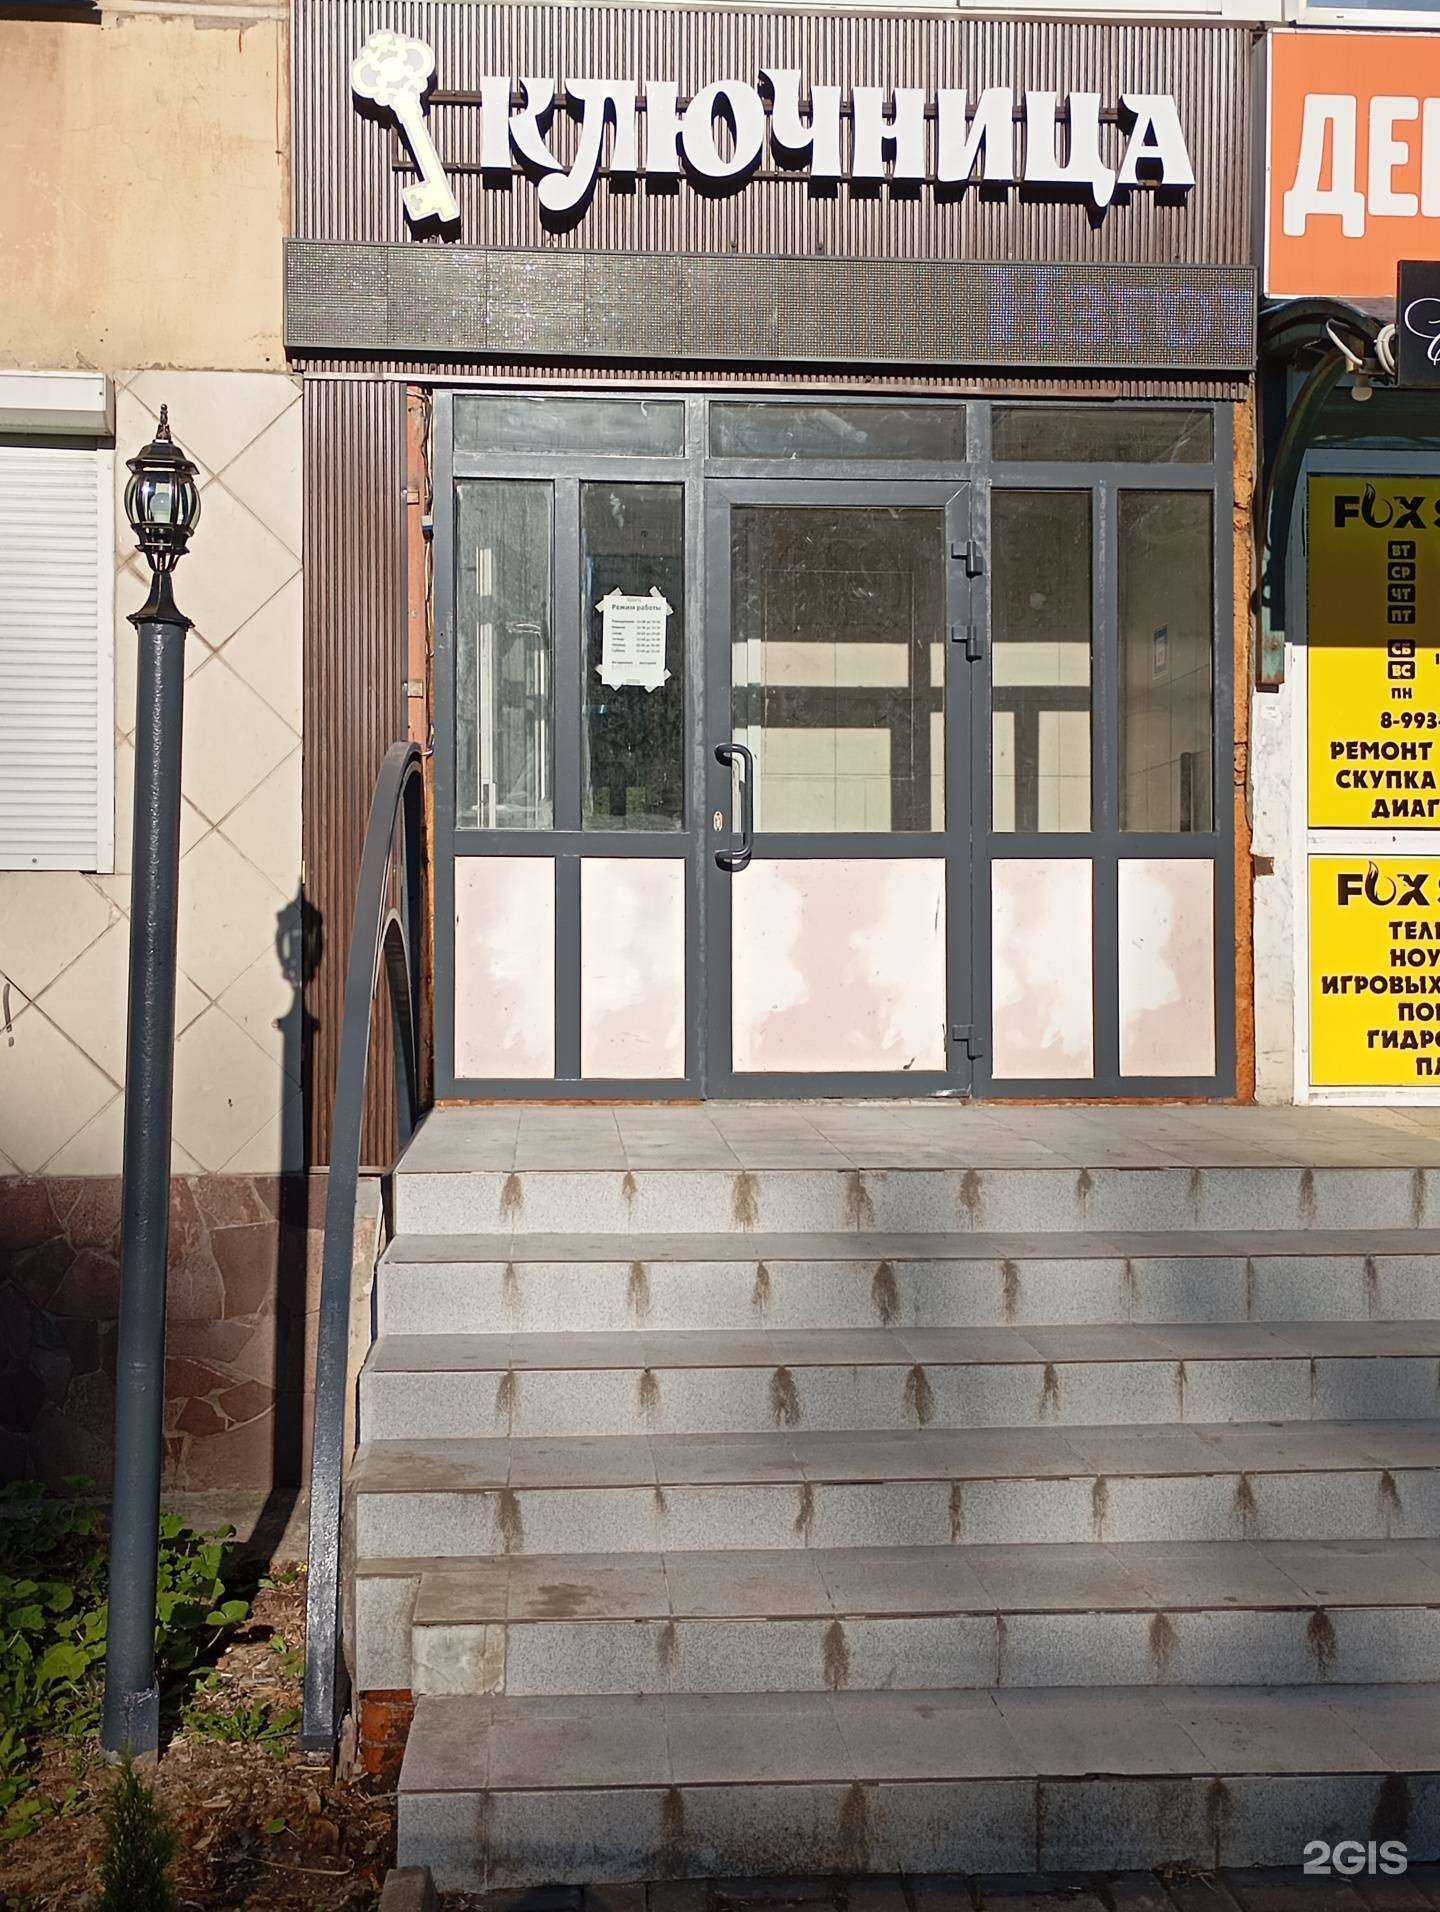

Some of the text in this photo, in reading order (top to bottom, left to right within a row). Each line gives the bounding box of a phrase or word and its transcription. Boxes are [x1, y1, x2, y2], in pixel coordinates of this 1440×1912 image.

[481, 68, 1196, 211] КЛЮЧНИЦА
[1391, 544, 1411, 557] ВТ
[1391, 566, 1411, 578] СР
[1391, 588, 1411, 600] ЧТ
[1391, 609, 1412, 622] ПТ
[1391, 642, 1412, 655] СБ
[1391, 663, 1412, 677] ВС
[1390, 687, 1413, 699] ПН
[1330, 741, 1433, 761] РЕМОНТ
[1336, 769, 1437, 789] СКУПКА
[1371, 799, 1440, 819] ДИАГ
[1321, 975, 1440, 995] ИГРОВЫХ
